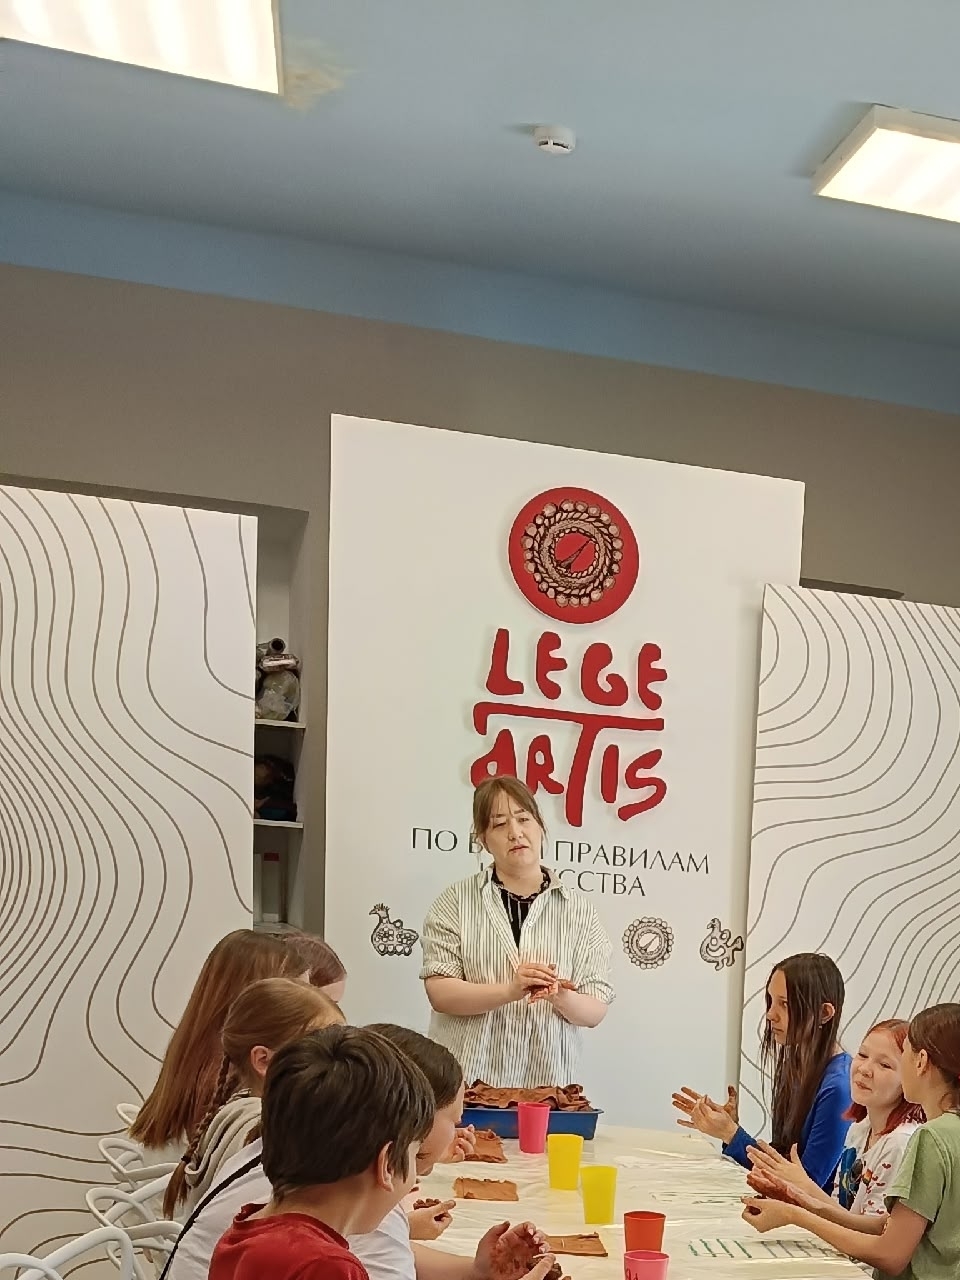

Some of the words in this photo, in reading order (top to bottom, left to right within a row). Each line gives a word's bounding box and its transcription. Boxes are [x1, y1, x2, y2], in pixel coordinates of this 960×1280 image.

[486, 629, 667, 710] LEGE
[471, 702, 667, 826] ARTIS
[412, 828, 458, 851] ПО
[555, 840, 709, 875] ПРАВИЛАМ
